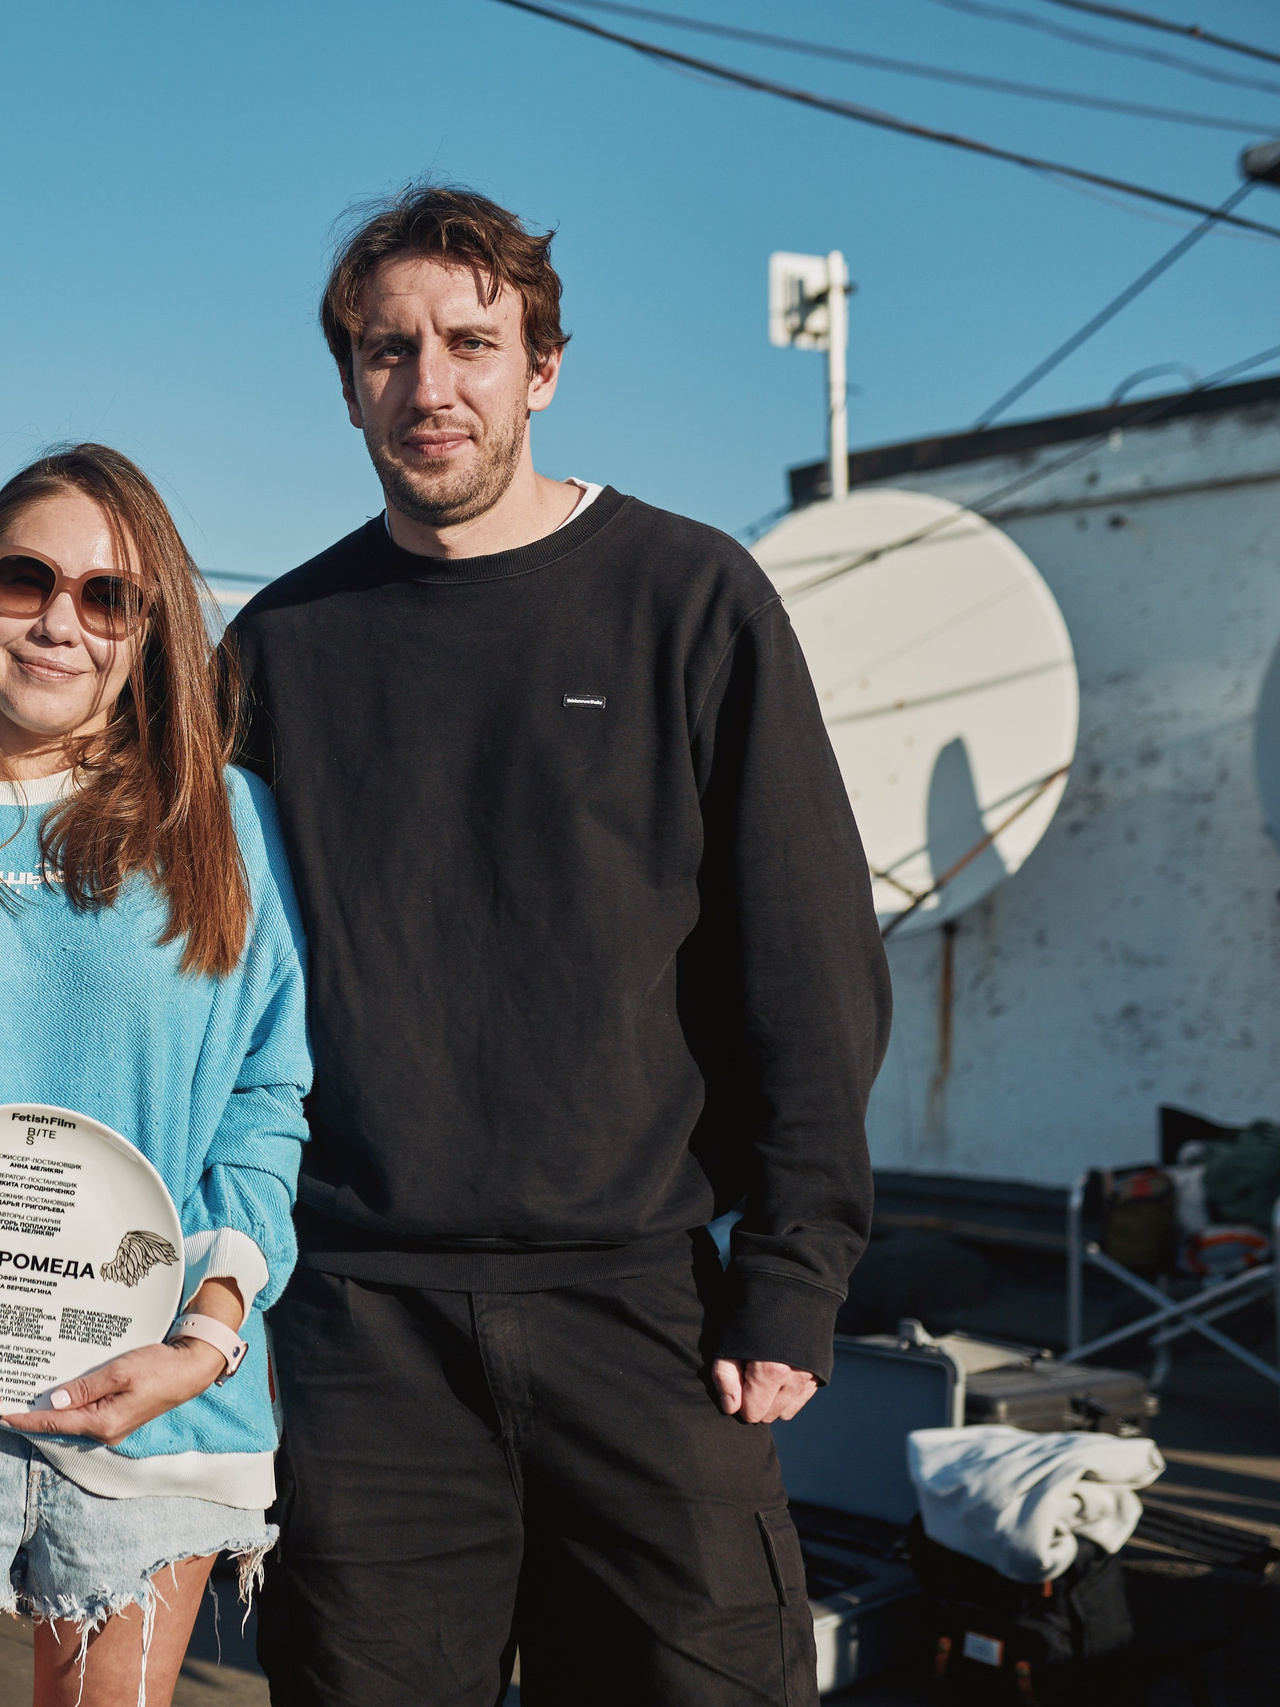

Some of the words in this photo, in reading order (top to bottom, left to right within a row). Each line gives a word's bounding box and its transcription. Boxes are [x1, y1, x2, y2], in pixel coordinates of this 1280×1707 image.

[12, 1113, 76, 1129] FetishFilm
[9, 1162, 29, 1170] АННА
[30, 1165, 64, 1175] МЕЛИКЯН
[20, 1183, 76, 1196] ГОРОДНИЧЕНКО
[21, 1203, 65, 1214] ГРИГОРЬЕВА
[26, 1215, 61, 1225] СЦЕНАРИЯ
[1, 1224, 20, 1232] АННА
[21, 1227, 54, 1237] МЕЛИКЯН
[20, 1221, 61, 1233] ПОПЛАУХИН
[19, 1276, 58, 1287] ТРИБУНЦЕВ
[6, 1284, 52, 1296] ВЕРЕЩАГИНА
[62, 1307, 85, 1315] ИРИНА
[13, 1345, 56, 1357] ПРОДЮСЕРЫ
[20, 1370, 58, 1381] ПРОДЮСЕР
